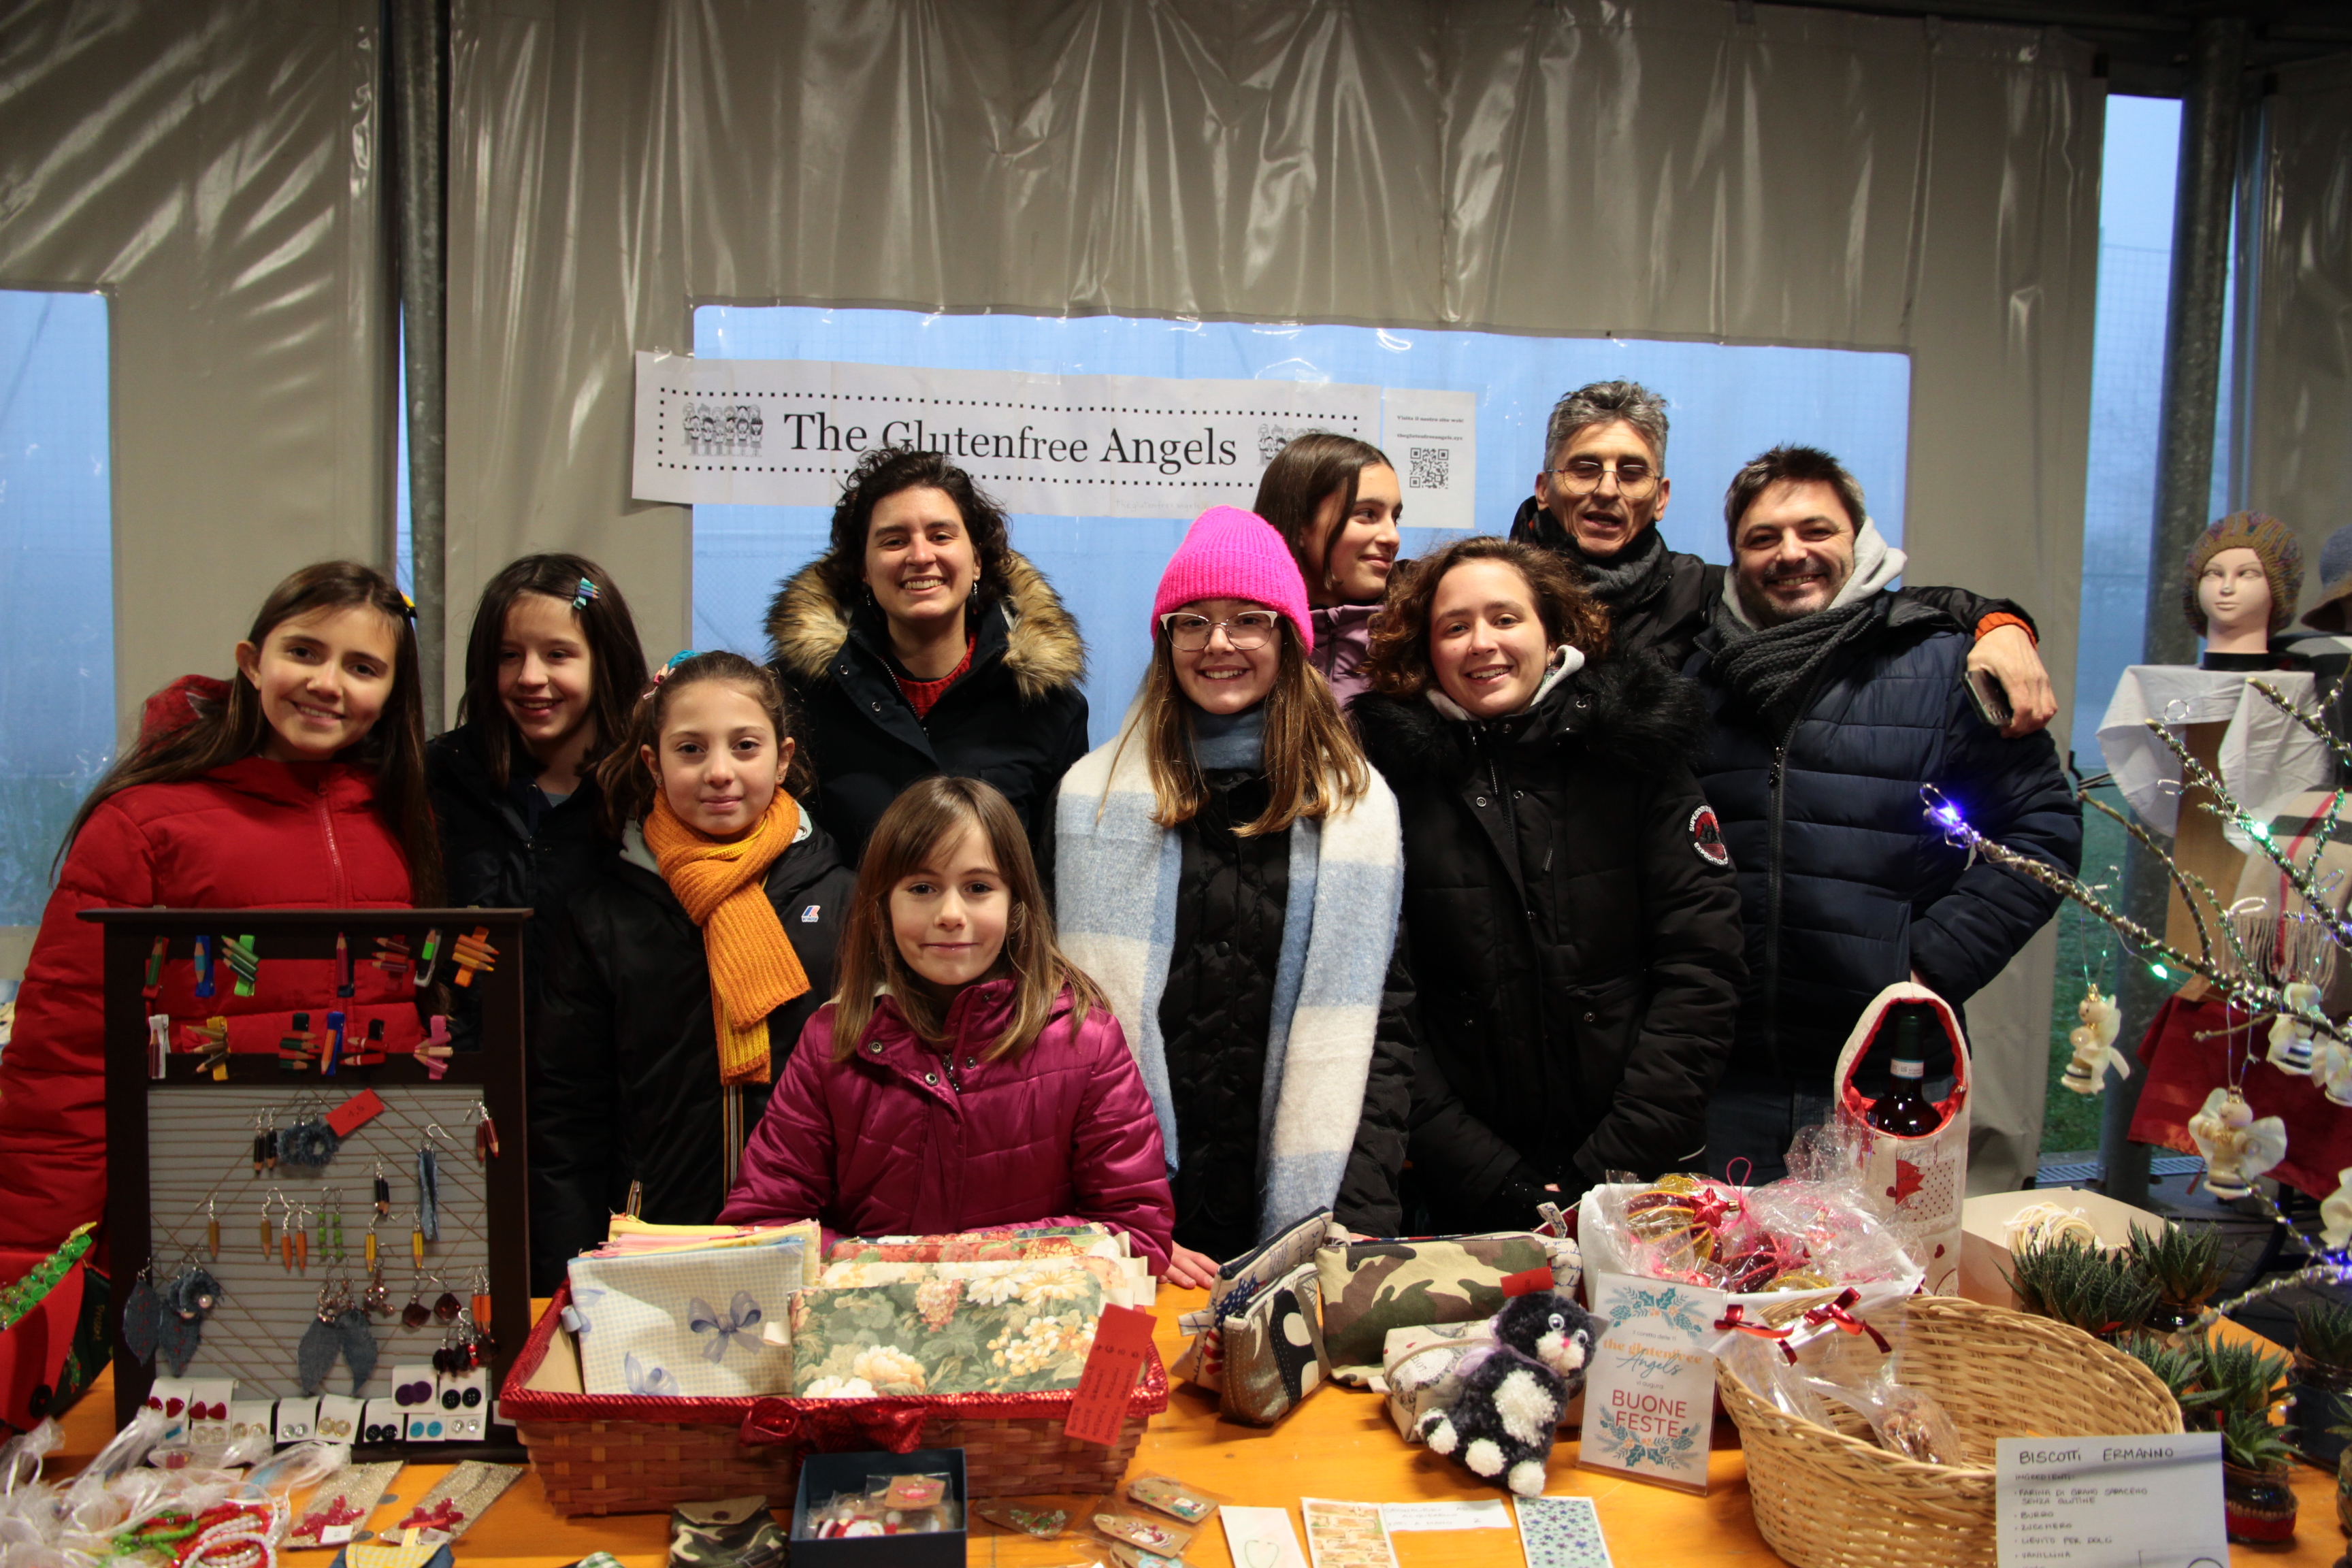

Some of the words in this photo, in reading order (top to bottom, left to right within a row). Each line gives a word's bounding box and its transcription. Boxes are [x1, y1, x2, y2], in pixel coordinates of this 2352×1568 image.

[784, 412, 867, 453] The
[882, 419, 1088, 463] Glutenfree
[1100, 426, 1237, 474] Angels
[1603, 1338, 1625, 1352] the
[1616, 1348, 1683, 1379] Angels
[1642, 1381, 1664, 1390] augura
[1612, 1389, 1687, 1418] BUONE
[1615, 1410, 1680, 1438] FESTE
[2103, 1447, 2174, 1462] ERMANNO
[2021, 1511, 2054, 1520] BURRO
